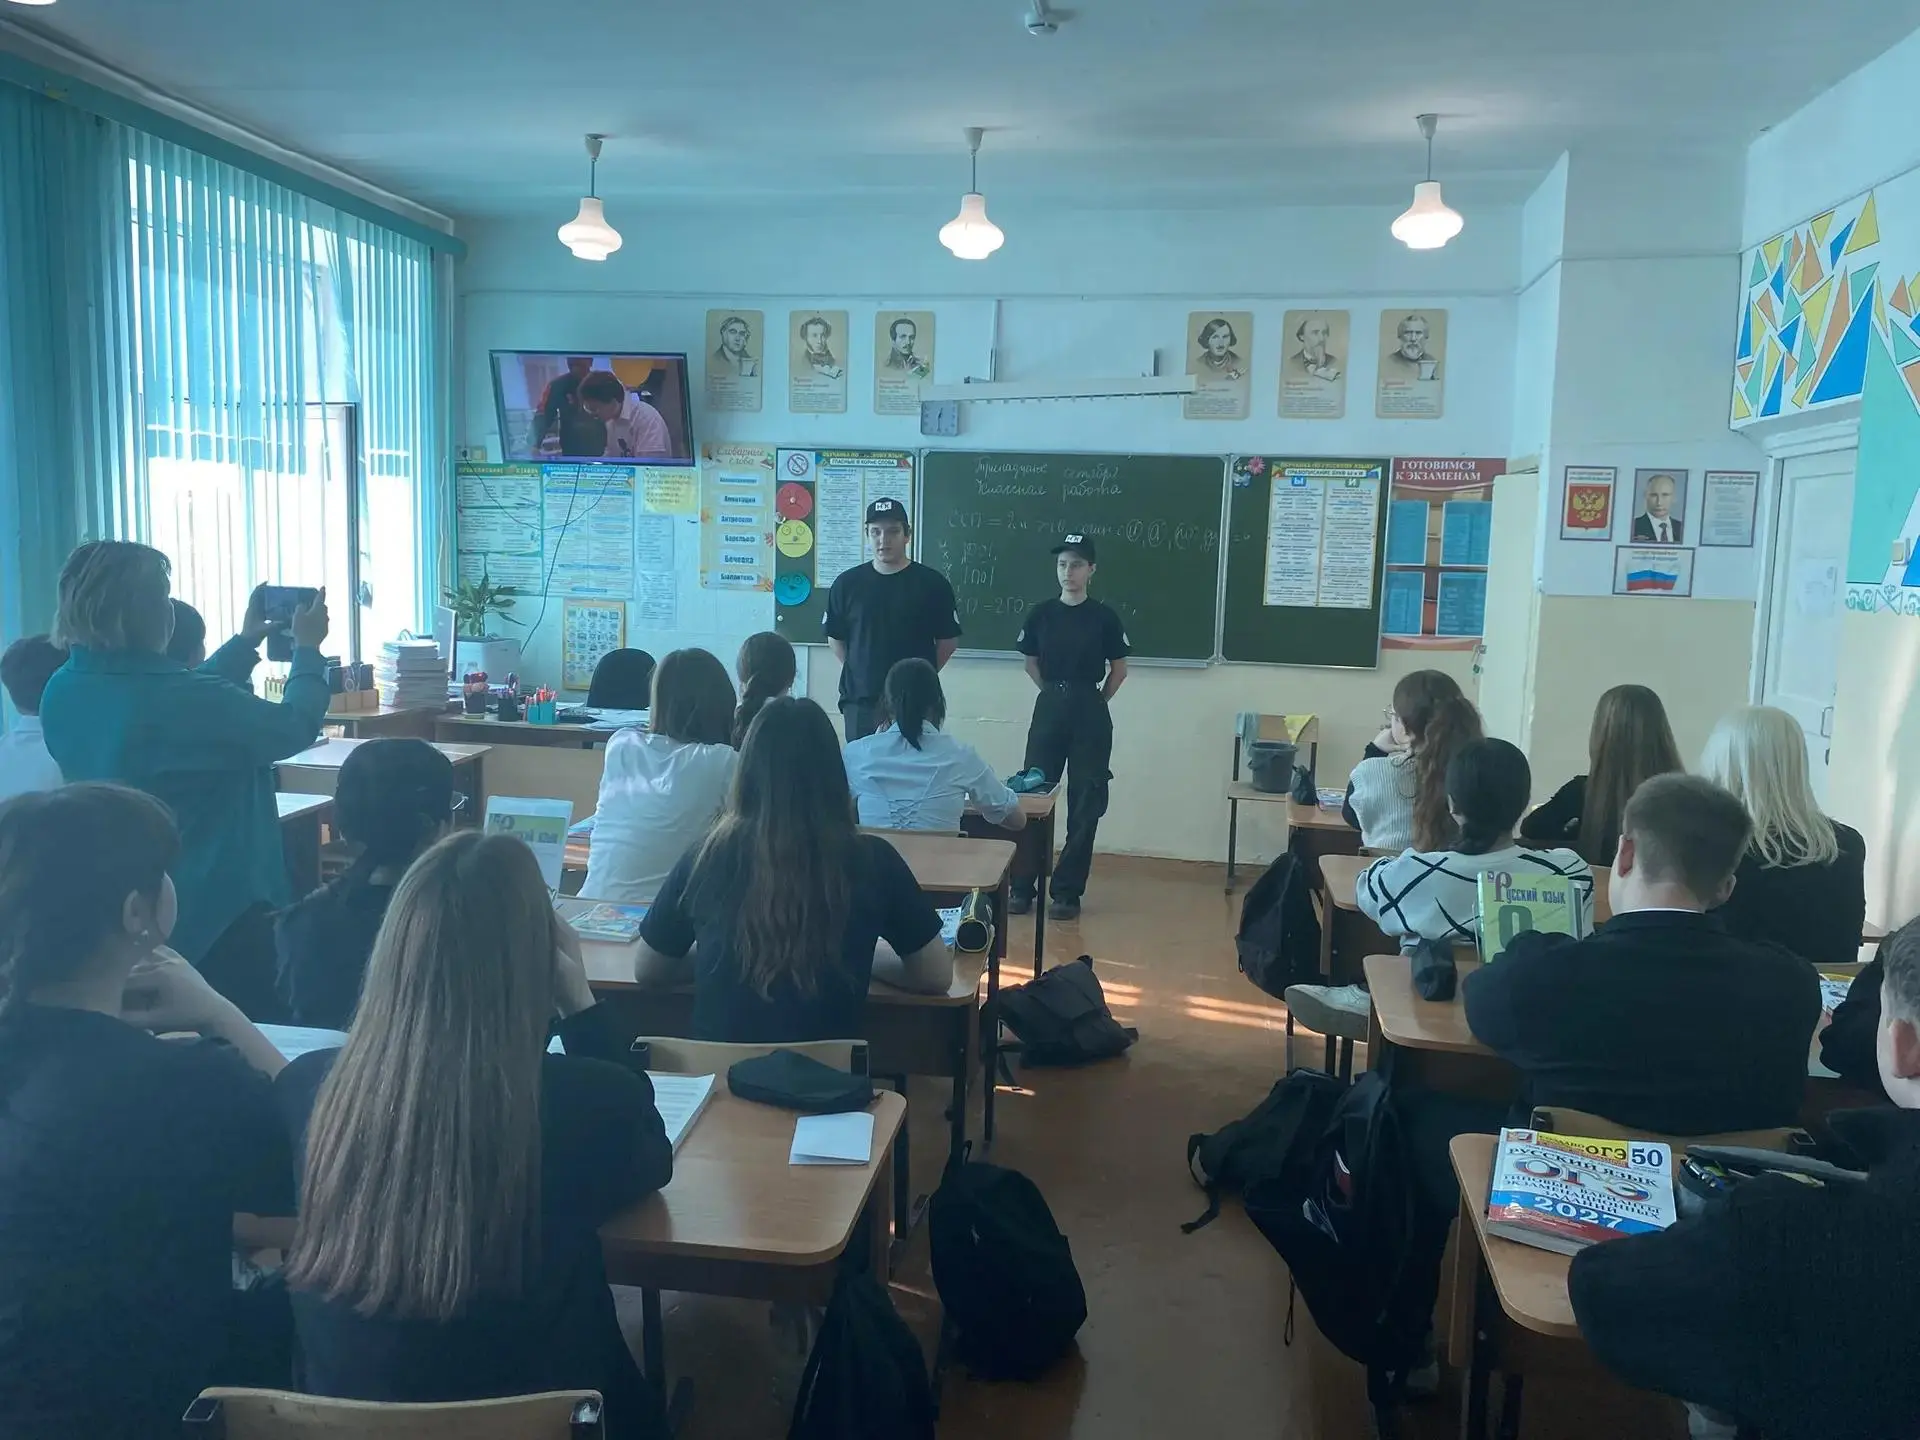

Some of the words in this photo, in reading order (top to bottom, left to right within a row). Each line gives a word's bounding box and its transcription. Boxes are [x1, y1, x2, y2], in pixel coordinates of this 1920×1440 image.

[1395, 471, 1404, 480] К
[1406, 471, 1481, 481] ЭКЗАМЕНАМ
[1401, 460, 1476, 470] ГОТОВИМСЯ
[1294, 475, 1304, 483] Ы
[1348, 476, 1357, 485] И
[1063, 480, 1121, 503] работа
[1493, 871, 1538, 904] Русский
[1541, 890, 1566, 905] язык
[1585, 1144, 1627, 1161] ОГЭ
[1631, 1147, 1663, 1167] 50
[1509, 1148, 1597, 1171] РУССКИЙ
[1603, 1168, 1659, 1188] ЯЗЫК
[1513, 1156, 1653, 1202] ОГЭ
[1504, 1175, 1573, 1190] ТИПОВЫЕ
[1580, 1187, 1660, 1215] ВАРИАНТЫ
[1504, 1180, 1661, 1220] ЭКЗАМЕНАЦИОННЫХ
[1543, 1190, 1618, 1214] ЗАДАНИЙ
[1533, 1195, 1623, 1229] 2027
